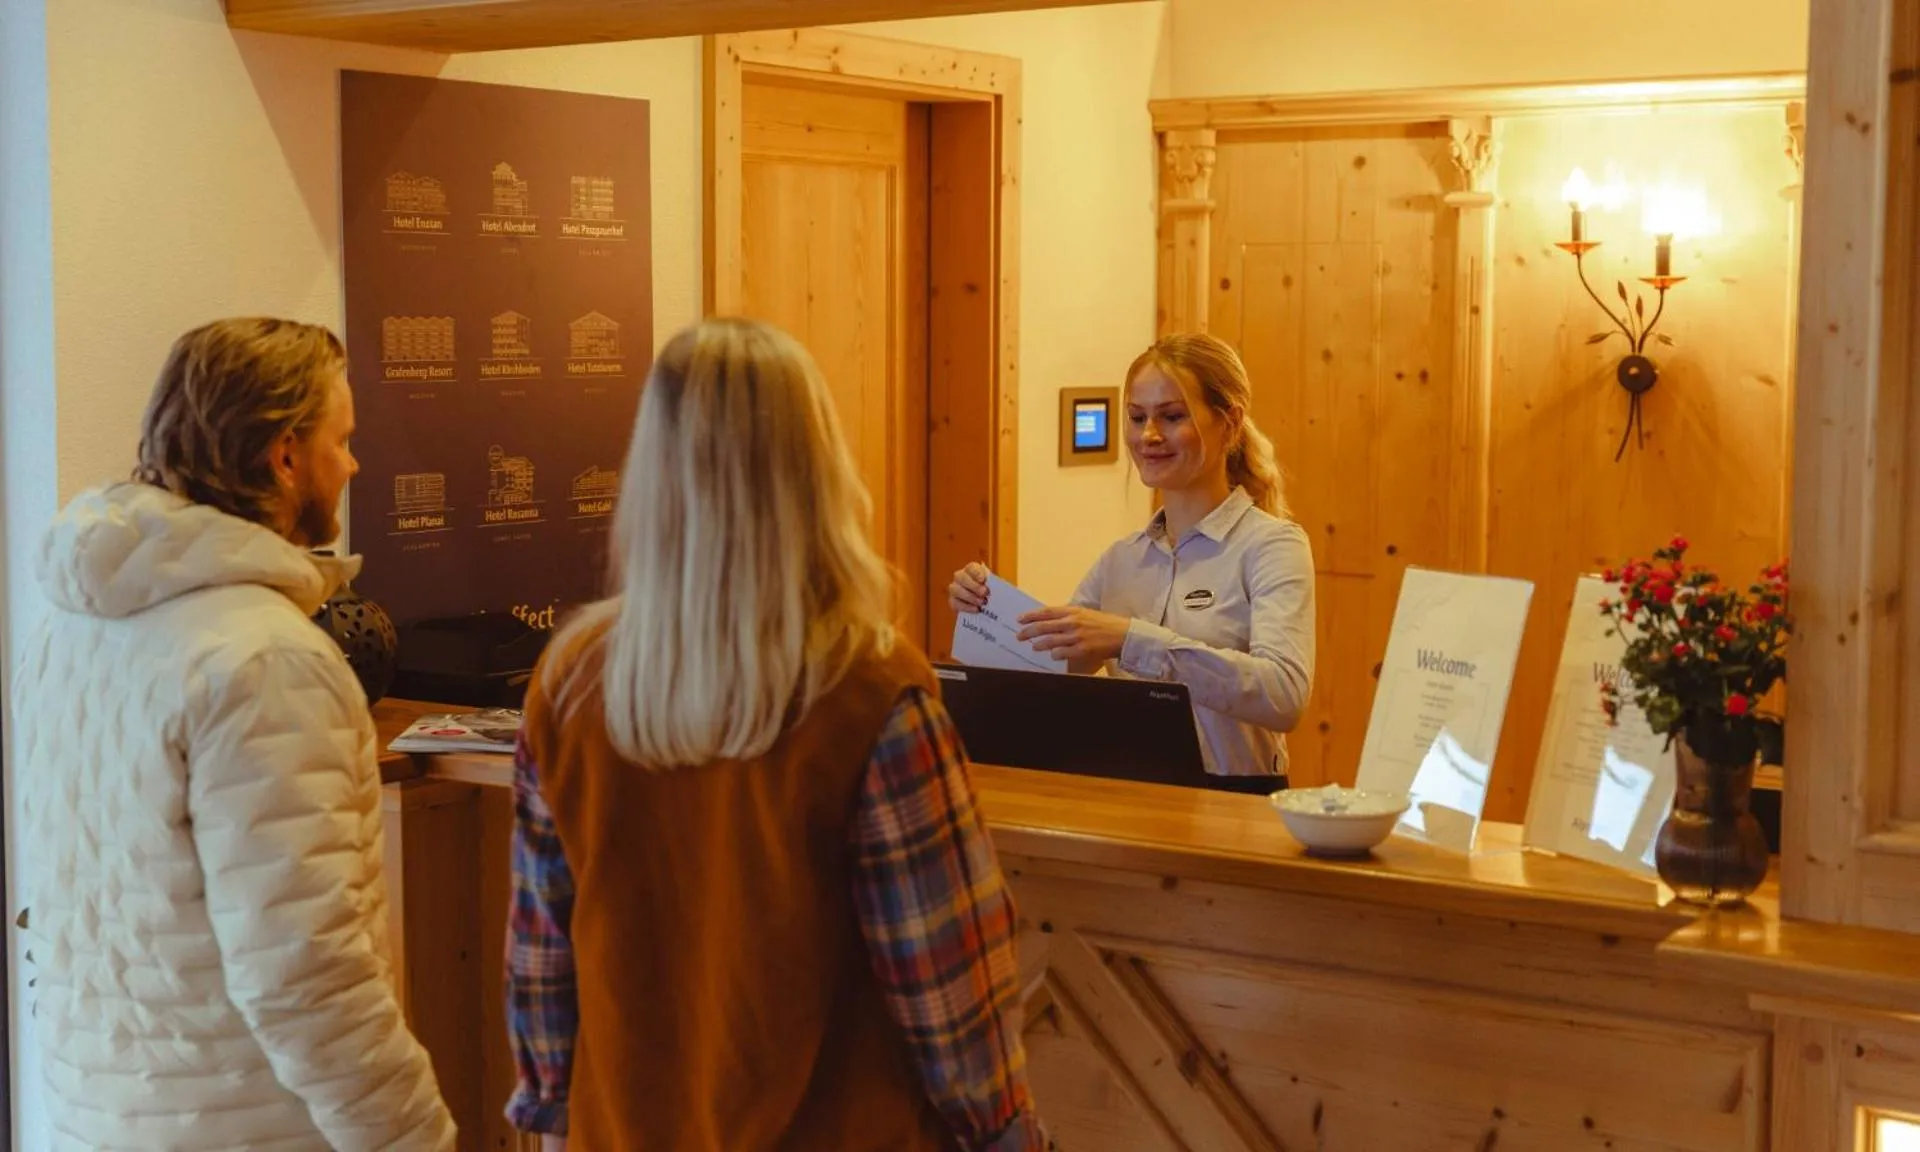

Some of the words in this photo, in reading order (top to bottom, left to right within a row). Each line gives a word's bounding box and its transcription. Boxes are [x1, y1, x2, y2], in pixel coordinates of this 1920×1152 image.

[393, 216, 414, 229] Hotel
[481, 219, 502, 232] Hotel
[562, 223, 580, 234] Hotel
[481, 364, 501, 375] Hotel
[578, 501, 596, 513] Hotel
[485, 507, 507, 522] Hotel
[398, 516, 419, 529] Hotel
[1417, 648, 1477, 679] Welcome
